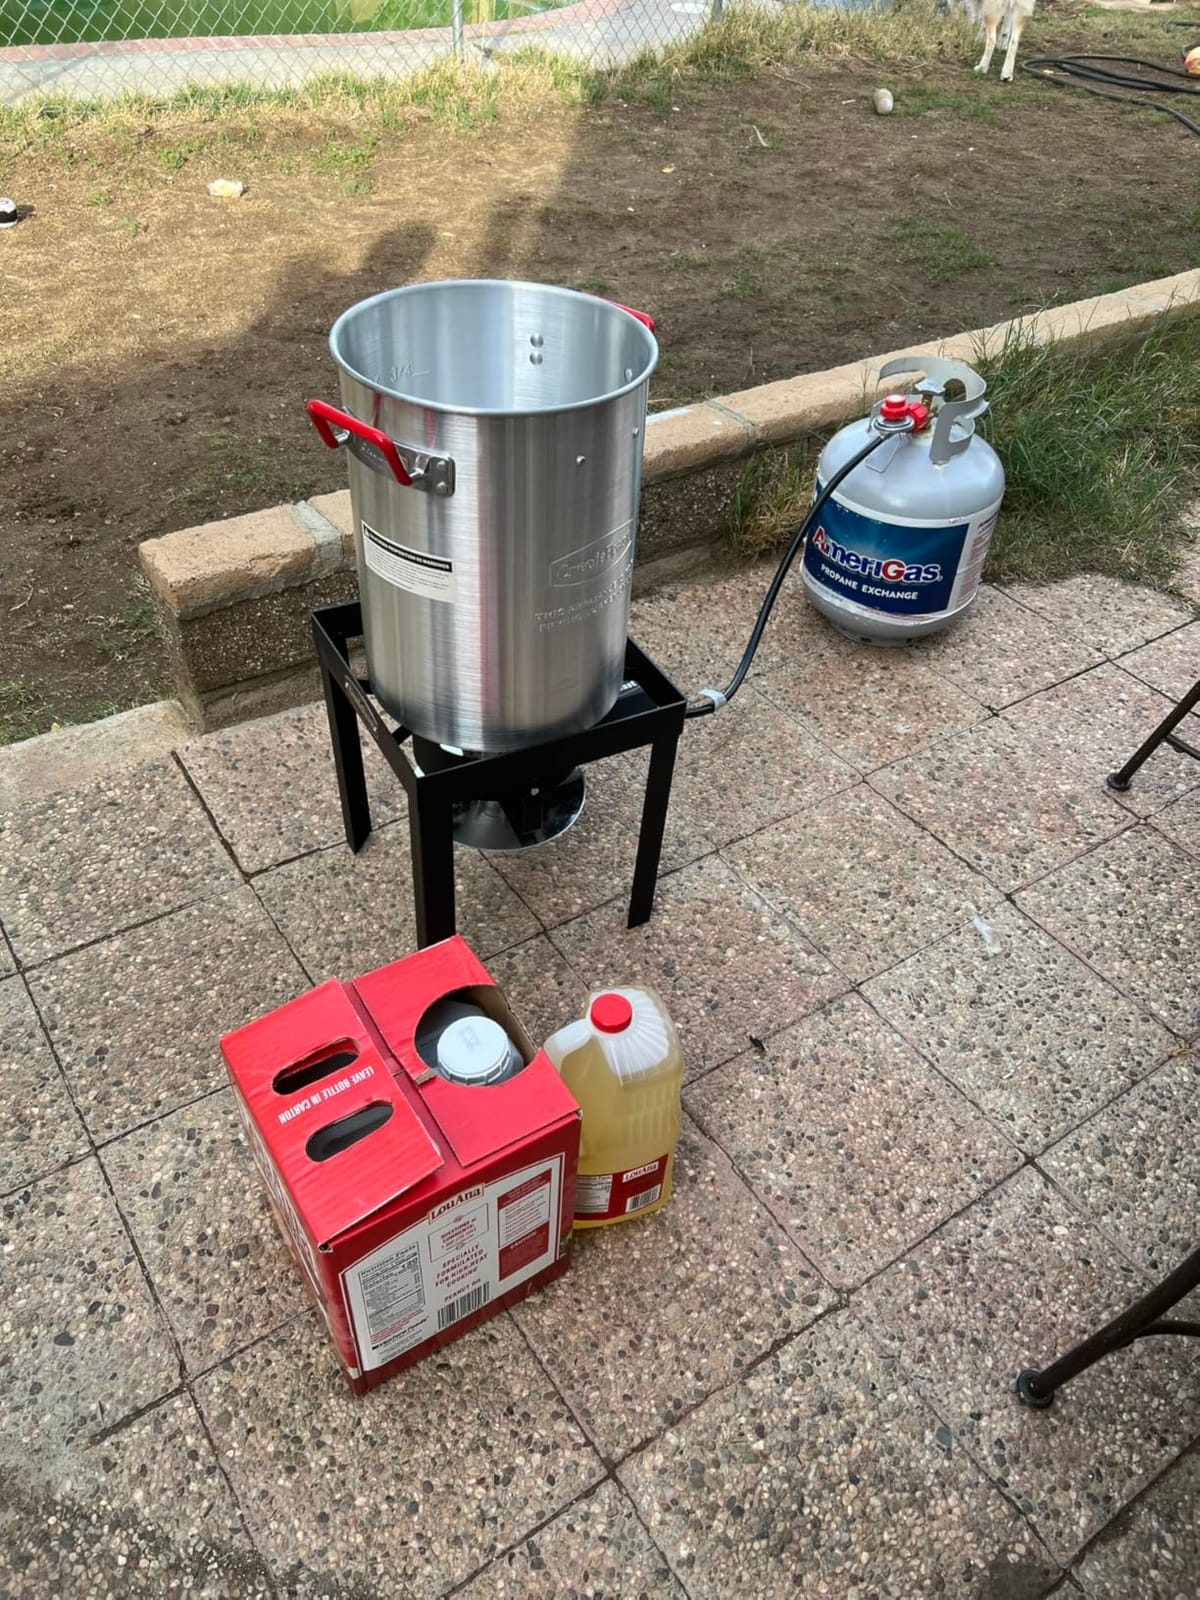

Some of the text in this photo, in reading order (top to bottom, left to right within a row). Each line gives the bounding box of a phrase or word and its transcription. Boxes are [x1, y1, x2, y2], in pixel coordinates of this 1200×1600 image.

[812, 525, 939, 583] AmeriGas
[820, 563, 858, 590] PROPANE
[861, 584, 919, 601] EXCHANGE
[278, 1065, 375, 1125] LEAVE BOTTLE IN CARTON
[624, 1162, 658, 1182] LouAna
[430, 1187, 482, 1220] LouAna
[360, 1256, 394, 1276] Nutrition
[395, 1244, 417, 1258] Facts
[435, 1275, 449, 1287] FOR
[451, 1252, 488, 1278] HIGH-HEAT
[436, 1249, 484, 1279] FORMULATED
[442, 1243, 479, 1269] SPECIALLY
[444, 1284, 470, 1301] PEANUT
[446, 1266, 478, 1288] COOKING
